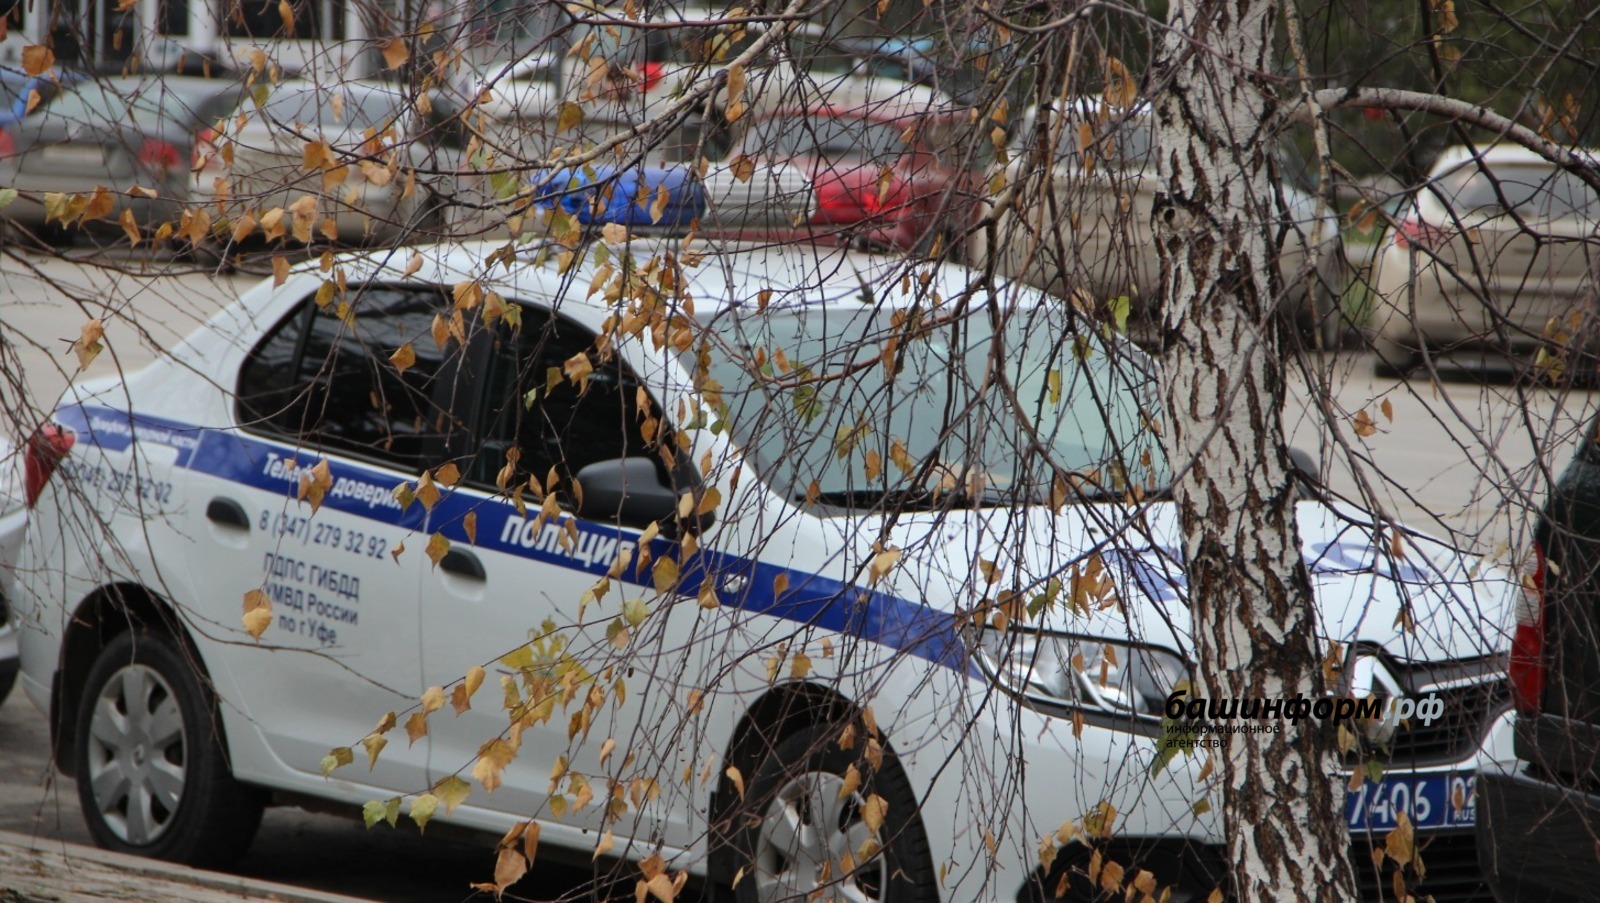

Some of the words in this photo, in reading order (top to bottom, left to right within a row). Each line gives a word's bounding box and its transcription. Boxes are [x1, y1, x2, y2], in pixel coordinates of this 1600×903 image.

[259, 509, 270, 531] 8
[272, 512, 311, 547] (347)
[313, 522, 342, 549] 279
[345, 530, 362, 555] 32
[367, 536, 388, 560] 92
[263, 552, 305, 583] ПДПС
[308, 564, 360, 604] ГИБДД
[278, 614, 297, 634] по
[299, 620, 307, 636] г
[307, 617, 338, 645] Уфе
[307, 593, 359, 627] России
[1347, 781, 1431, 825] 7406
[1454, 807, 1476, 821] RUS
